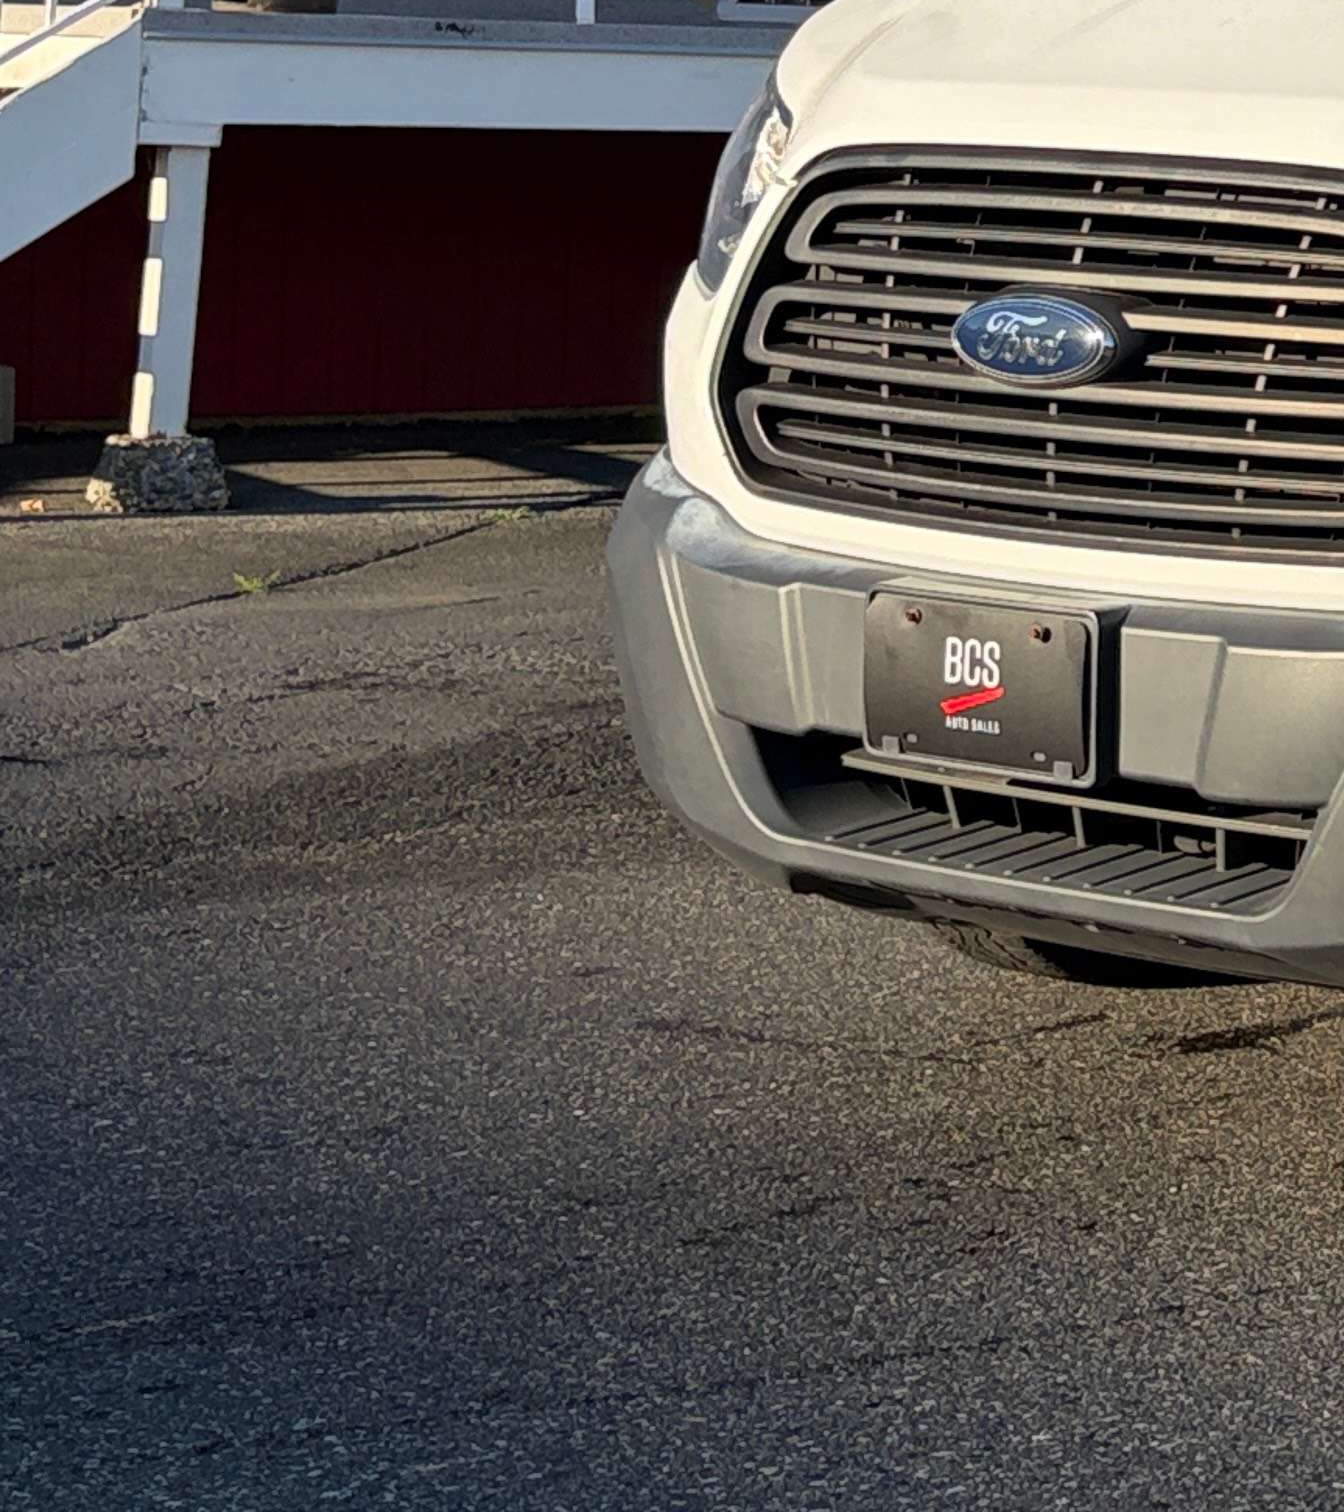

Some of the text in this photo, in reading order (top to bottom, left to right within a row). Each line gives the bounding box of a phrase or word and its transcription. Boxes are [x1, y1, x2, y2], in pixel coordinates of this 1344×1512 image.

[976, 311, 1067, 367] Ford
[944, 636, 1001, 689] BCS
[945, 714, 1001, 735] AUTO SALES
